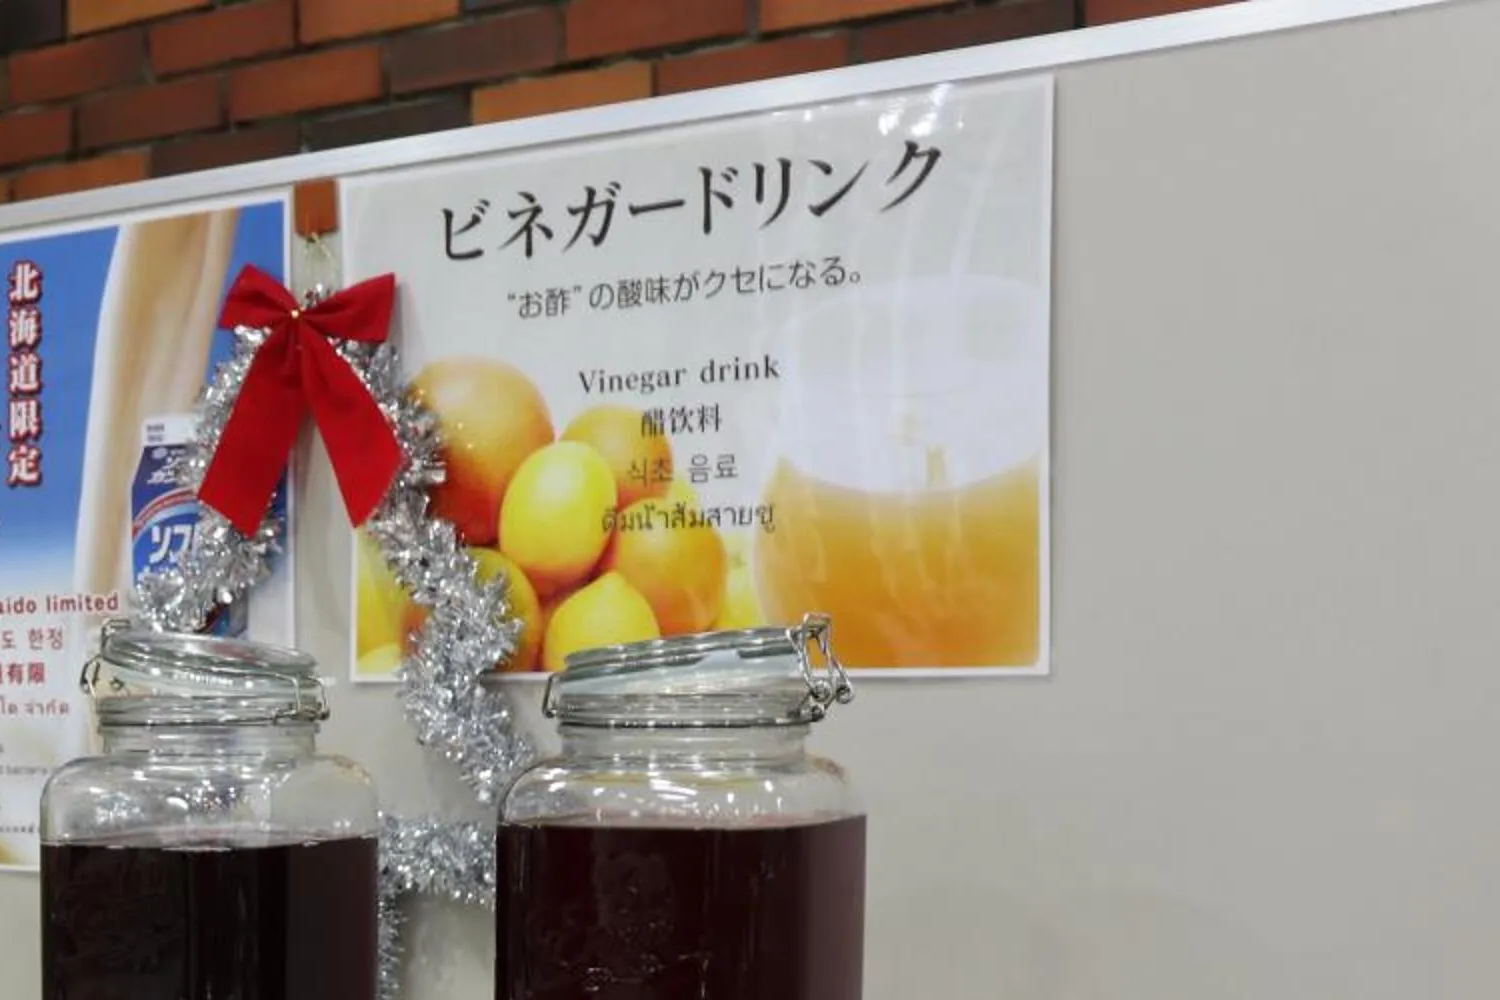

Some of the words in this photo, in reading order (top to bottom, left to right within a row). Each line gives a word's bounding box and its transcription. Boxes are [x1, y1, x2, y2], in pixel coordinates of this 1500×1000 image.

[441, 139, 943, 261] ビネガードリンク
[8, 261, 41, 486] 北海道限定
[579, 367, 688, 395] Vinegar
[700, 354, 780, 384] drink
[627, 457, 675, 487] 식초
[688, 453, 739, 483] 음료
[46, 592, 119, 613] limited
[28, 626, 63, 651] 한정
